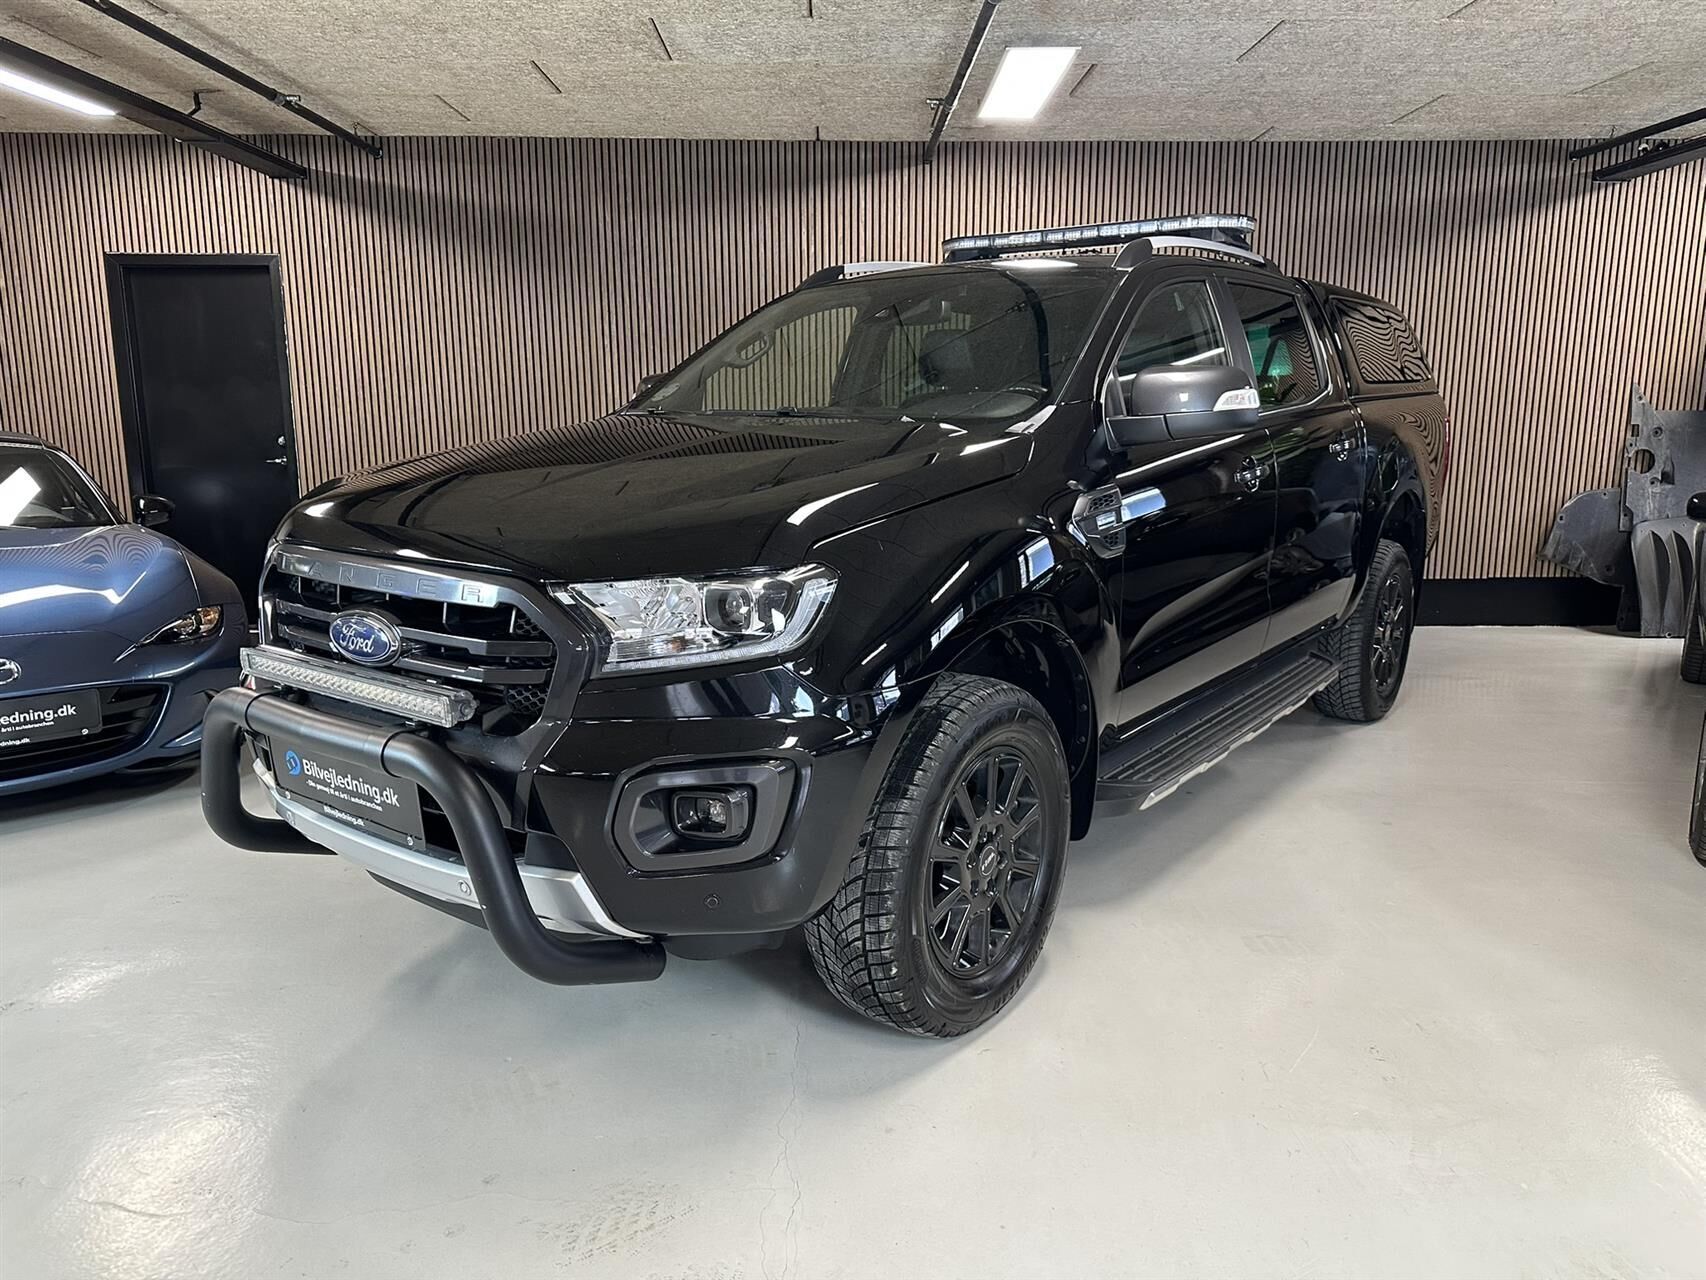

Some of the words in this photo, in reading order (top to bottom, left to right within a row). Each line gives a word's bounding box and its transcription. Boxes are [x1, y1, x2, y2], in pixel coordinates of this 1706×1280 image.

[340, 622, 375, 653] Ford
[0, 704, 77, 725] edning.dk
[302, 759, 400, 807] Bilvejledning.dk
